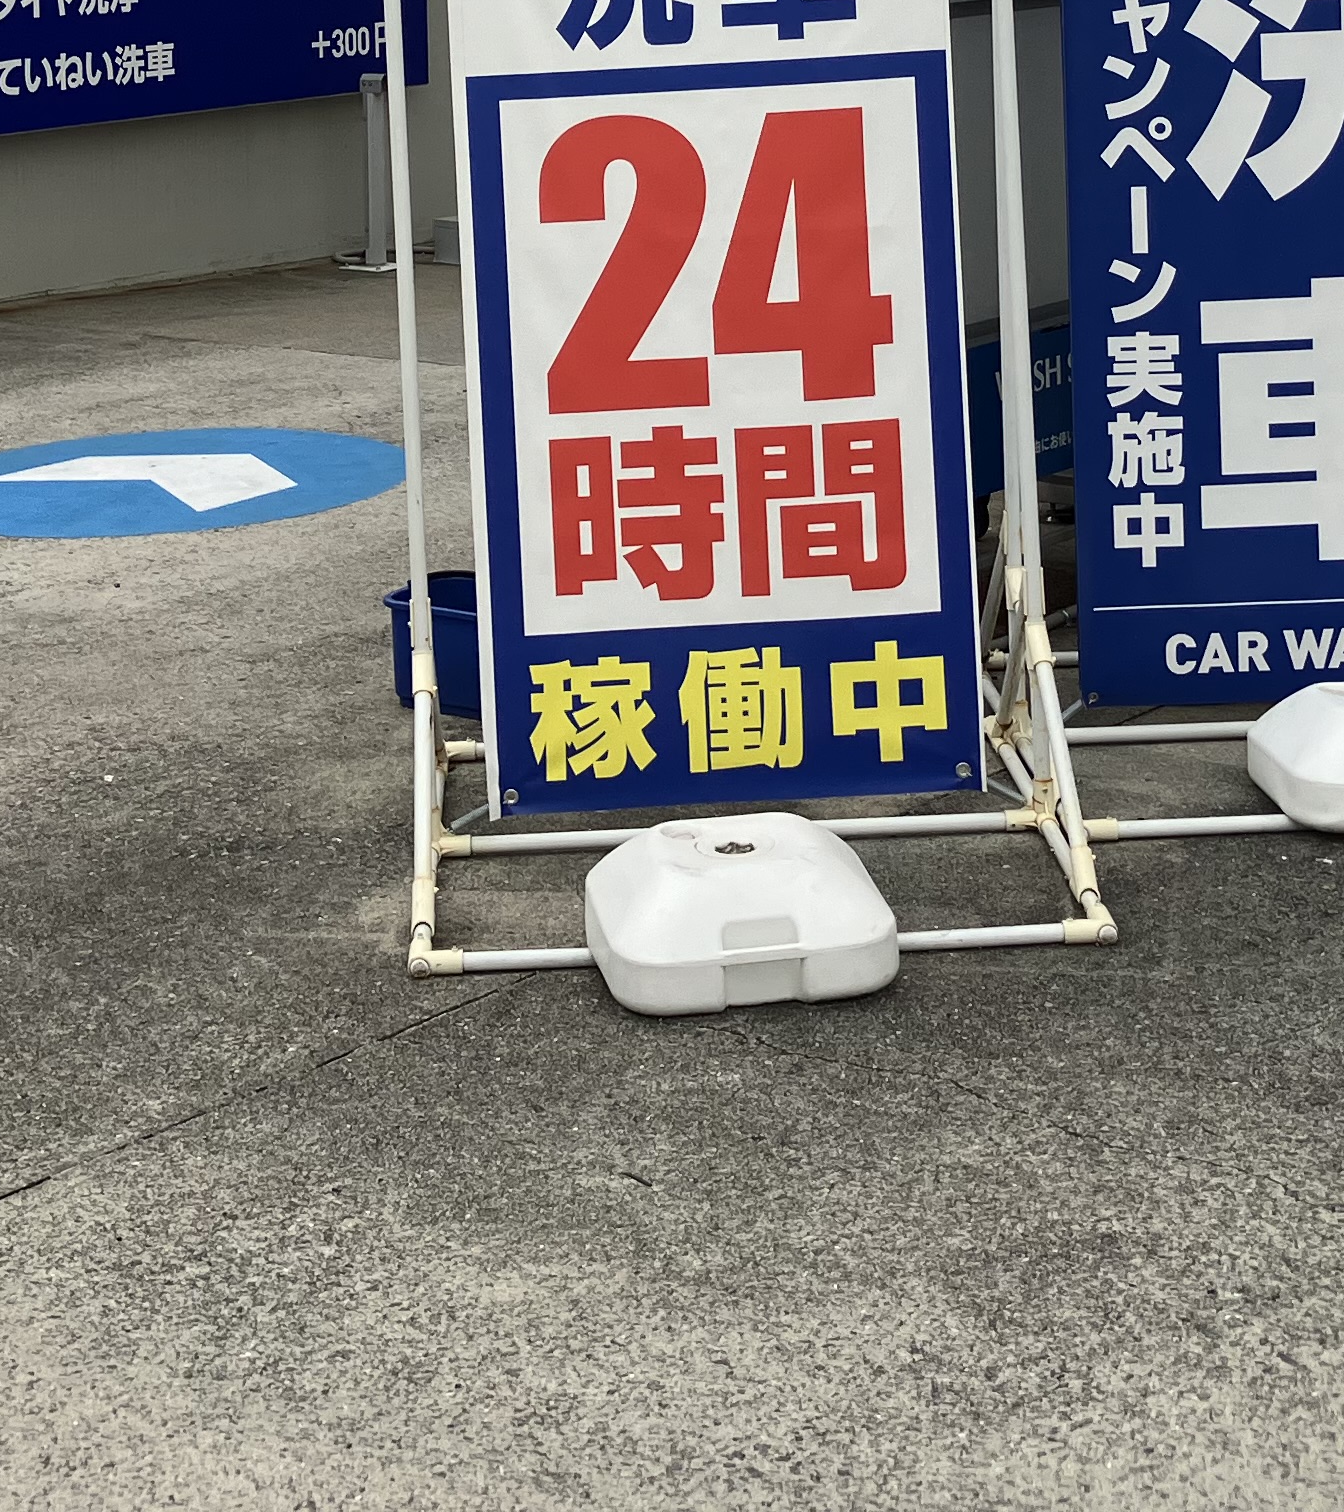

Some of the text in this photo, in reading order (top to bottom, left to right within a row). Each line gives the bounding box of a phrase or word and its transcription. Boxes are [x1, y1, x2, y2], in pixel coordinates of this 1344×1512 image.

[539, 107, 893, 414] 24
[548, 418, 907, 601] 時間
[529, 640, 948, 782] 稼働中
[1165, 632, 1270, 675] CAR
